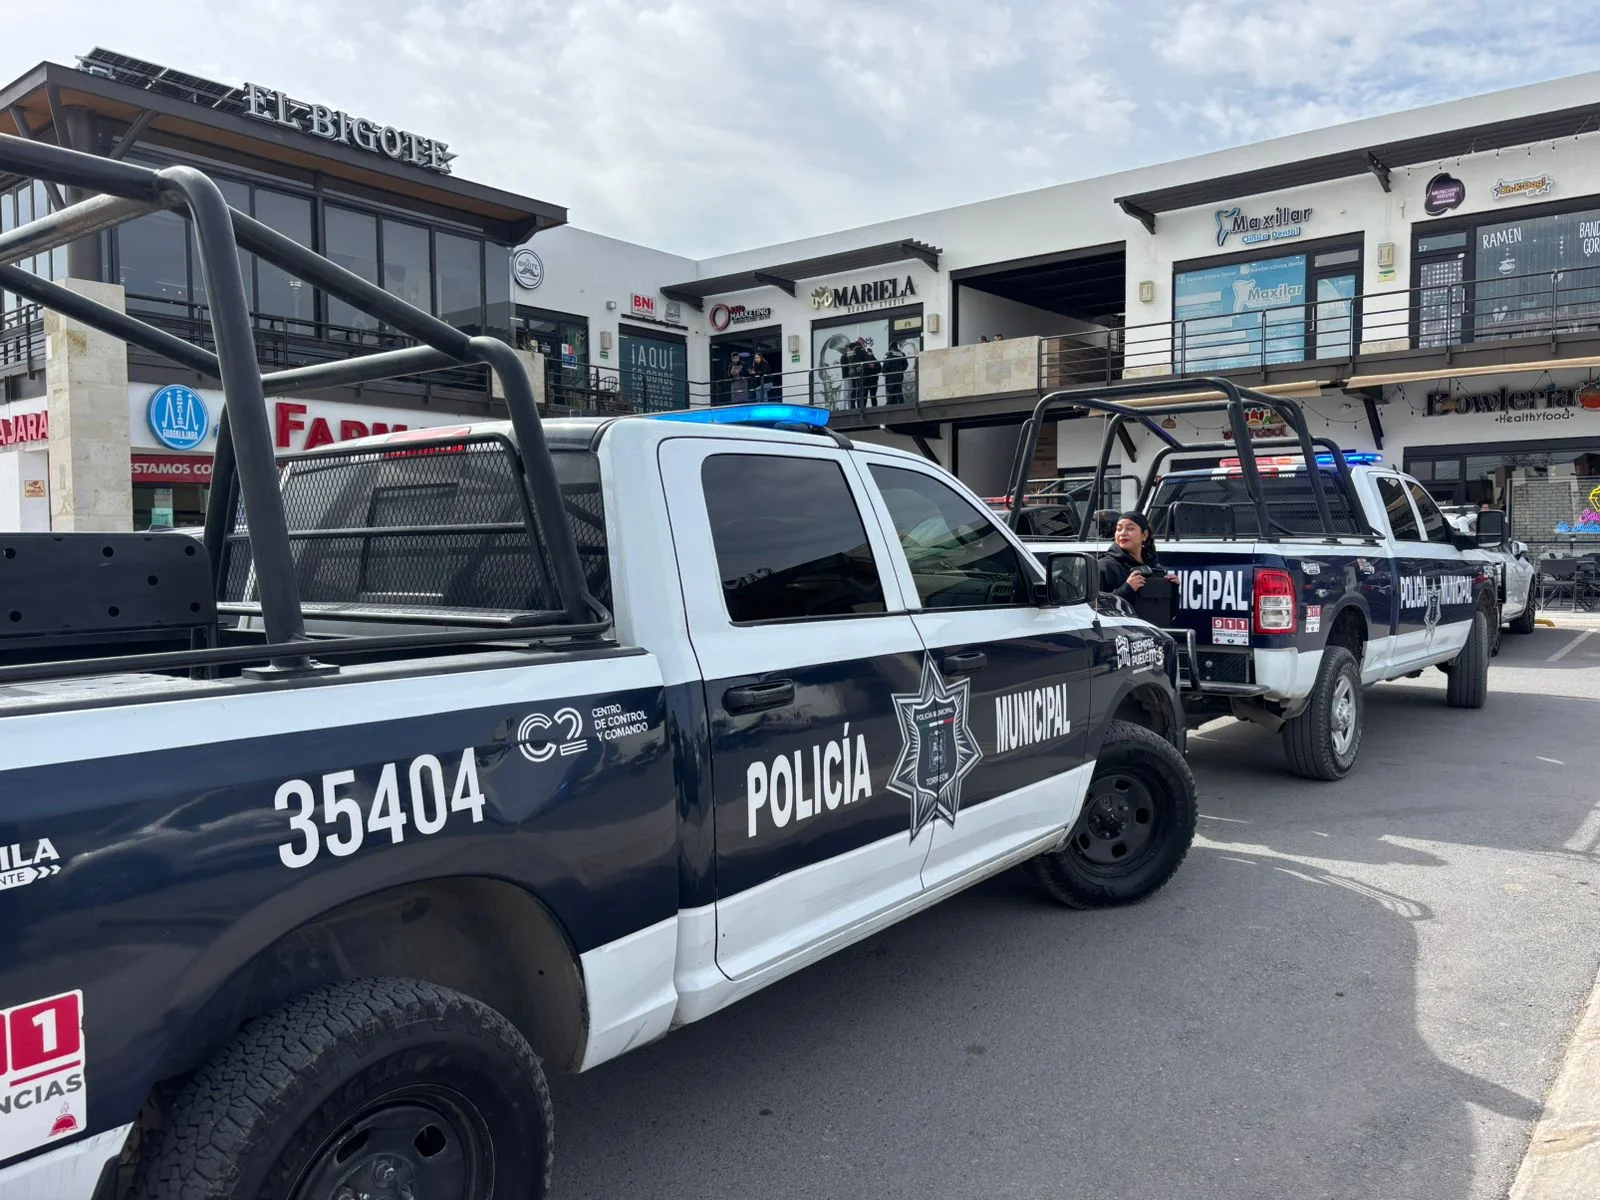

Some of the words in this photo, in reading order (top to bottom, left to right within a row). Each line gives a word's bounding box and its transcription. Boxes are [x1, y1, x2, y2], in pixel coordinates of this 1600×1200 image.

[244, 82, 302, 131] EL
[308, 103, 456, 174] BIGOTE
[1231, 207, 1312, 233] Maxilar
[1271, 226, 1300, 239] Dental
[1483, 227, 1522, 249] RAMEN
[833, 275, 916, 308] MARIELA
[1248, 283, 1304, 301] Maxilar
[730, 308, 770, 319] MARKETING
[848, 303, 874, 313] BEAUTY
[1440, 575, 1472, 605] MUNICIPAL
[1214, 619, 1247, 630] 911
[592, 704, 621, 717] CENTRO
[594, 719, 607, 730] DE
[608, 710, 647, 726] CONTROL
[995, 683, 1071, 754] MUNICIPAL
[518, 707, 588, 762] C2
[597, 732, 603, 741] Y
[605, 722, 648, 740] COMANDO
[747, 722, 872, 837] POLICÍA
[274, 746, 486, 869] 35404
[0, 838, 60, 871] ILA
